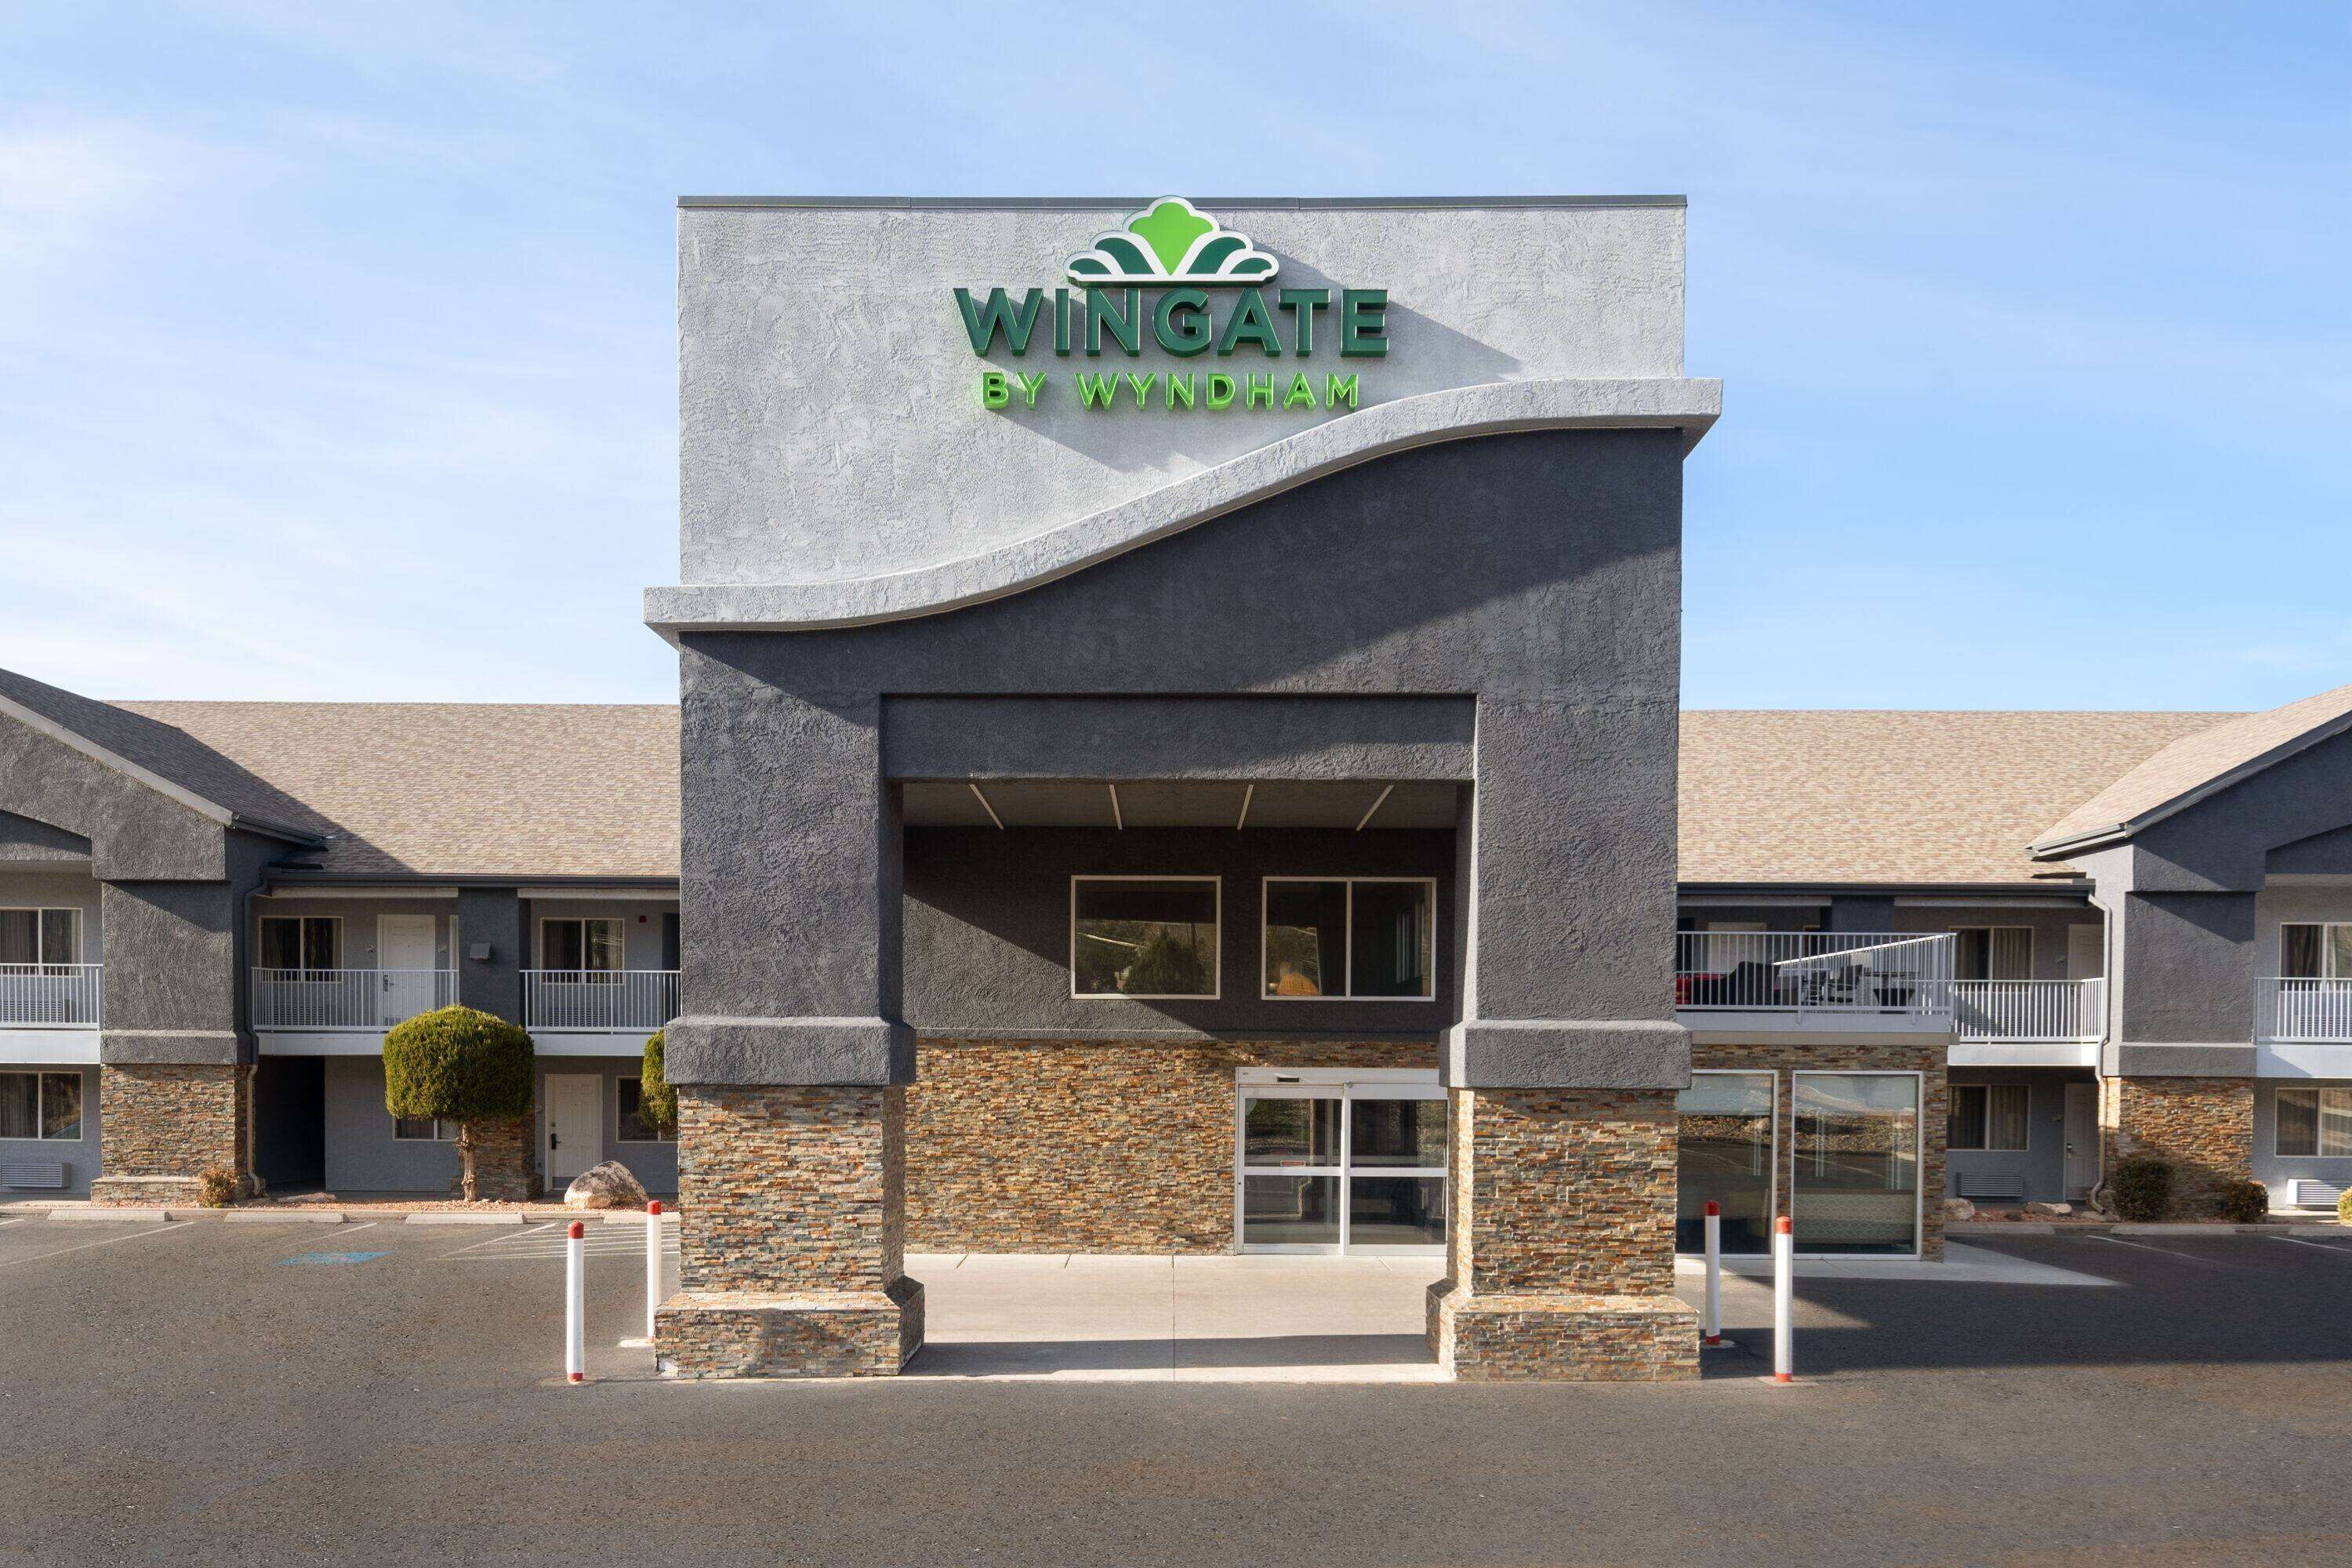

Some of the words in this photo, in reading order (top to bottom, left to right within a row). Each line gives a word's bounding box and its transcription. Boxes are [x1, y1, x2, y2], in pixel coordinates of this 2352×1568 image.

[953, 287, 1388, 358] WINGATE
[982, 372, 1046, 410] BY
[1074, 372, 1359, 411] WYNDHAM
